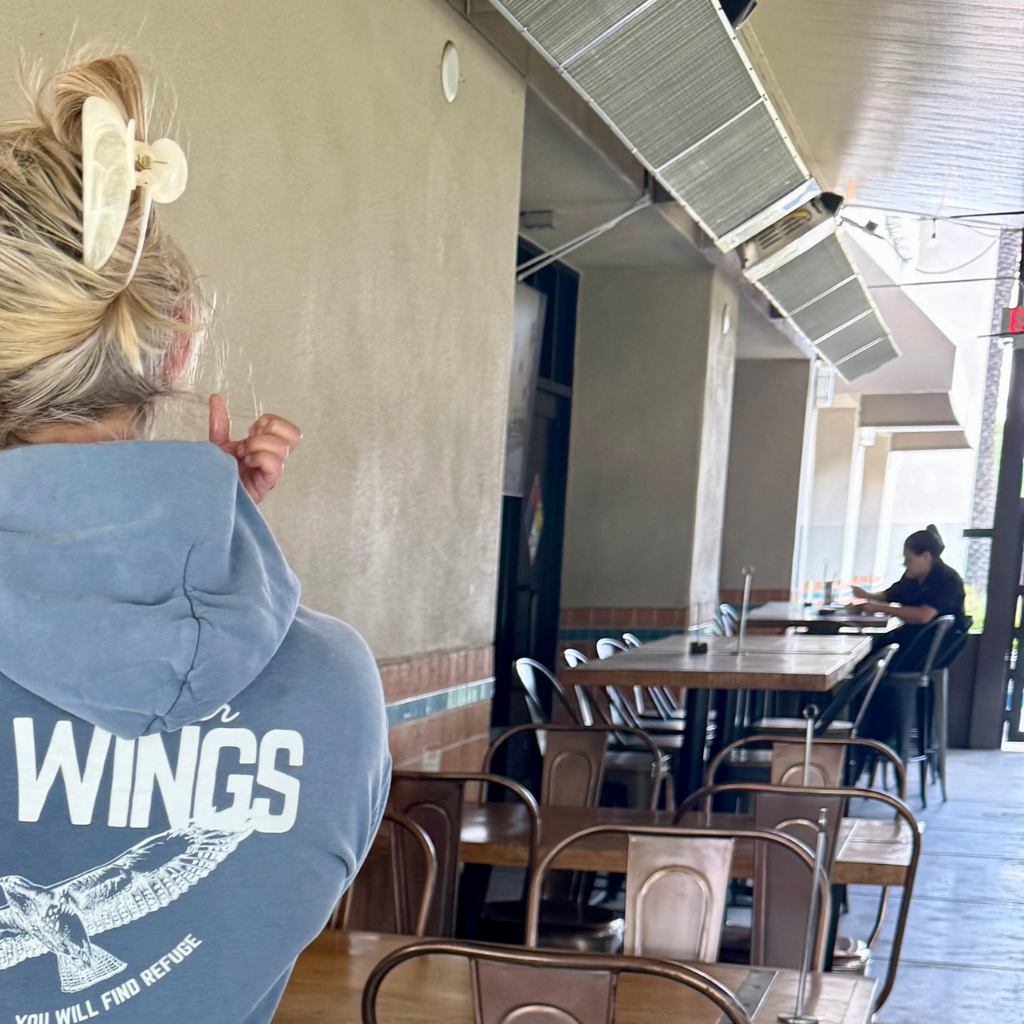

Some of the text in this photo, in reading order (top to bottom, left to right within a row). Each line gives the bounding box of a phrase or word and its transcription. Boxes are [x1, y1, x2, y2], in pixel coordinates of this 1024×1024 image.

[12, 716, 305, 834] WINGS
[100, 977, 141, 1011] FIND
[139, 933, 203, 987] REFUGE
